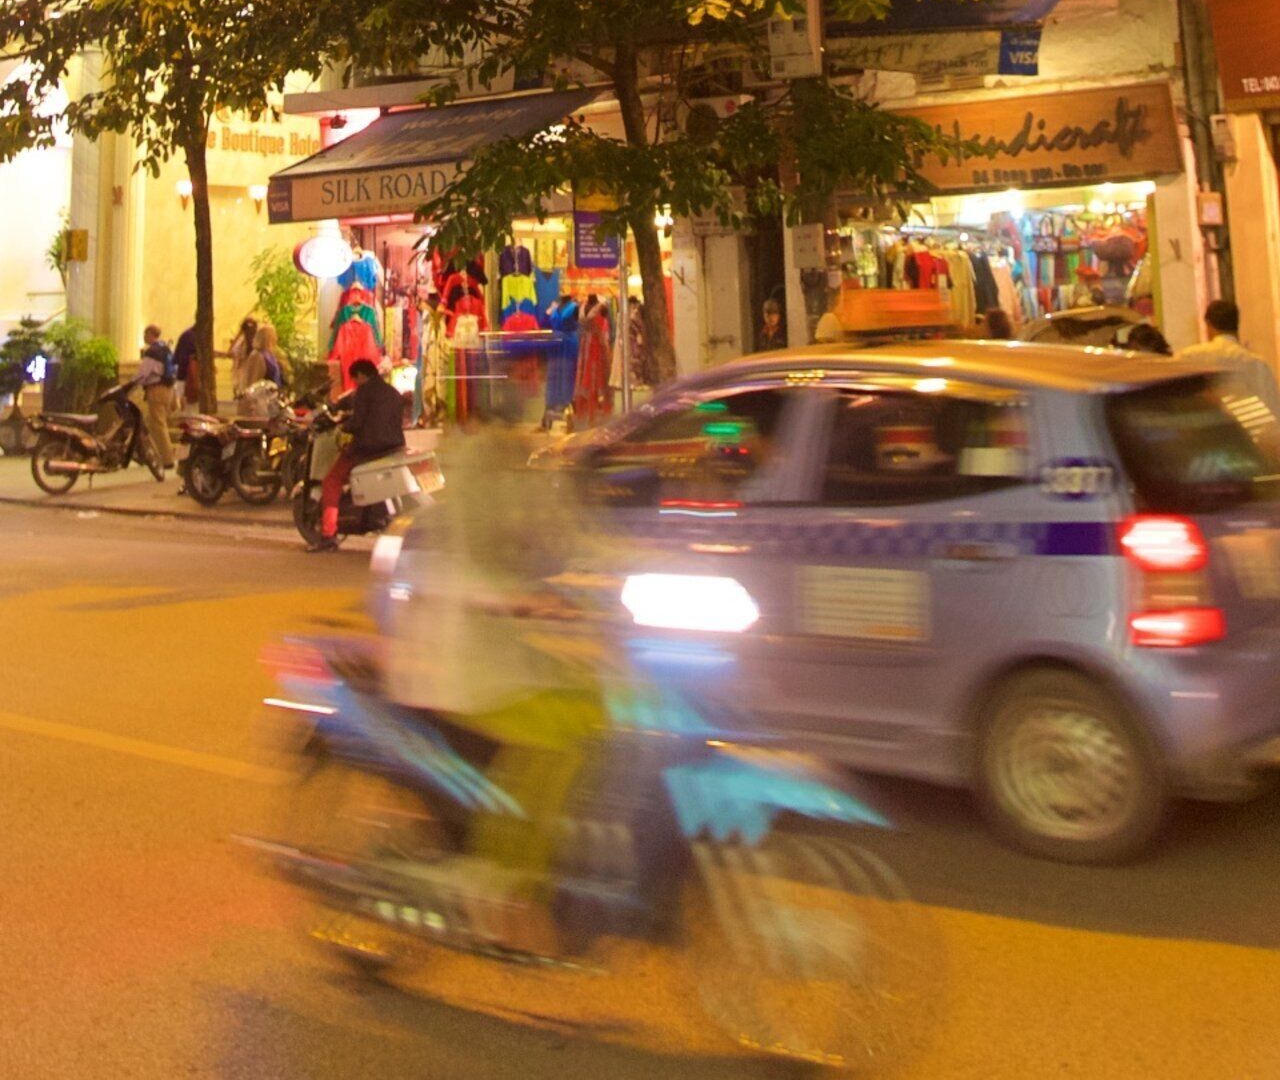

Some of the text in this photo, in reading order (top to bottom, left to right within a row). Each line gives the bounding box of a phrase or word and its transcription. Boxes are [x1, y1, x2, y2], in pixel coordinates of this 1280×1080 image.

[222, 126, 284, 157] Boutique
[321, 170, 448, 206] SILK ROAD
